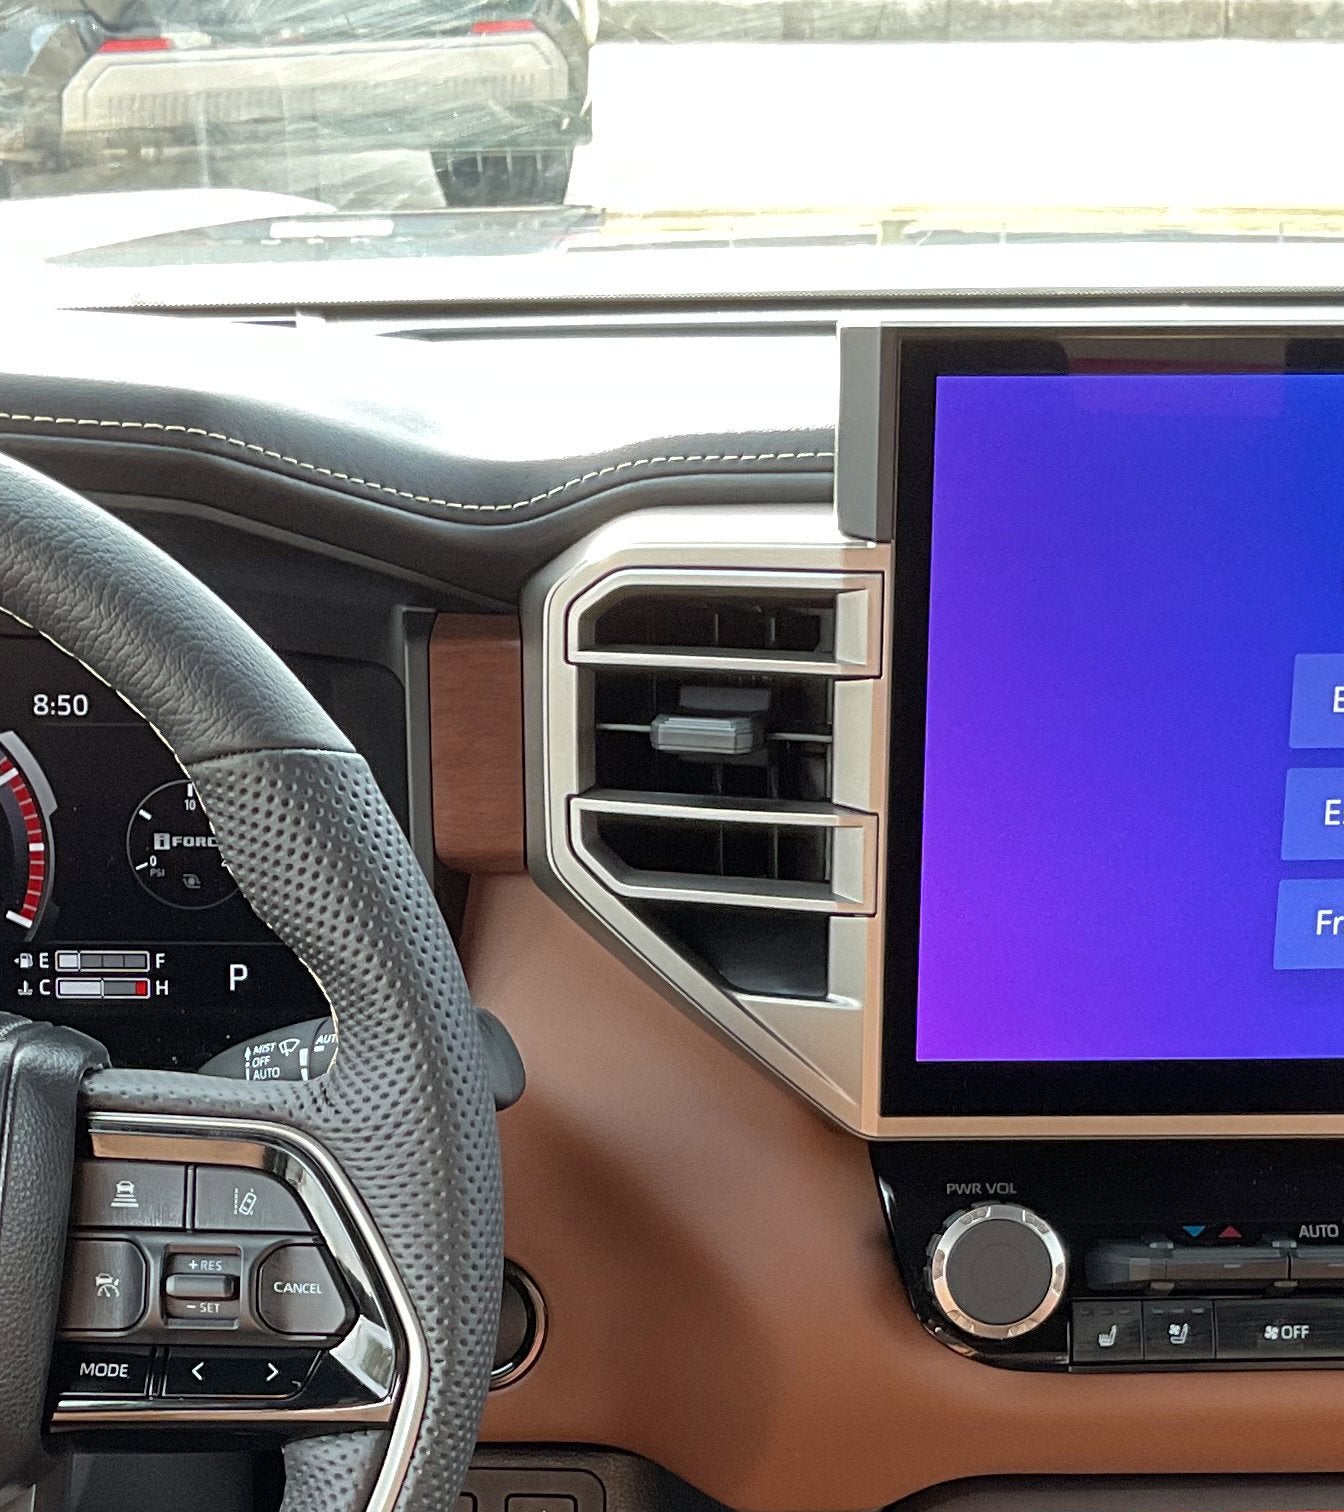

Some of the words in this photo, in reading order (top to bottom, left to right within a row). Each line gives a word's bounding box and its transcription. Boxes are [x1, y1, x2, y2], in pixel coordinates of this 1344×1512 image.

[32, 693, 89, 718] 8:50
[183, 799, 197, 811] 10
[149, 854, 157, 867] 0
[39, 953, 50, 969] E
[155, 953, 166, 969] F
[228, 963, 249, 992] P
[39, 979, 51, 995] C
[155, 979, 169, 996] H
[314, 1033, 338, 1045] AUT
[252, 1041, 277, 1055] MIST
[251, 1055, 271, 1068] OFF
[252, 1067, 281, 1081] AUTO
[946, 1182, 982, 1195] PWR
[984, 1181, 1018, 1195] VOL
[1298, 1224, 1339, 1239] AUTO
[273, 1281, 323, 1295] CANCEL
[1280, 1325, 1310, 1340] OFF
[79, 1362, 130, 1379] MODE
